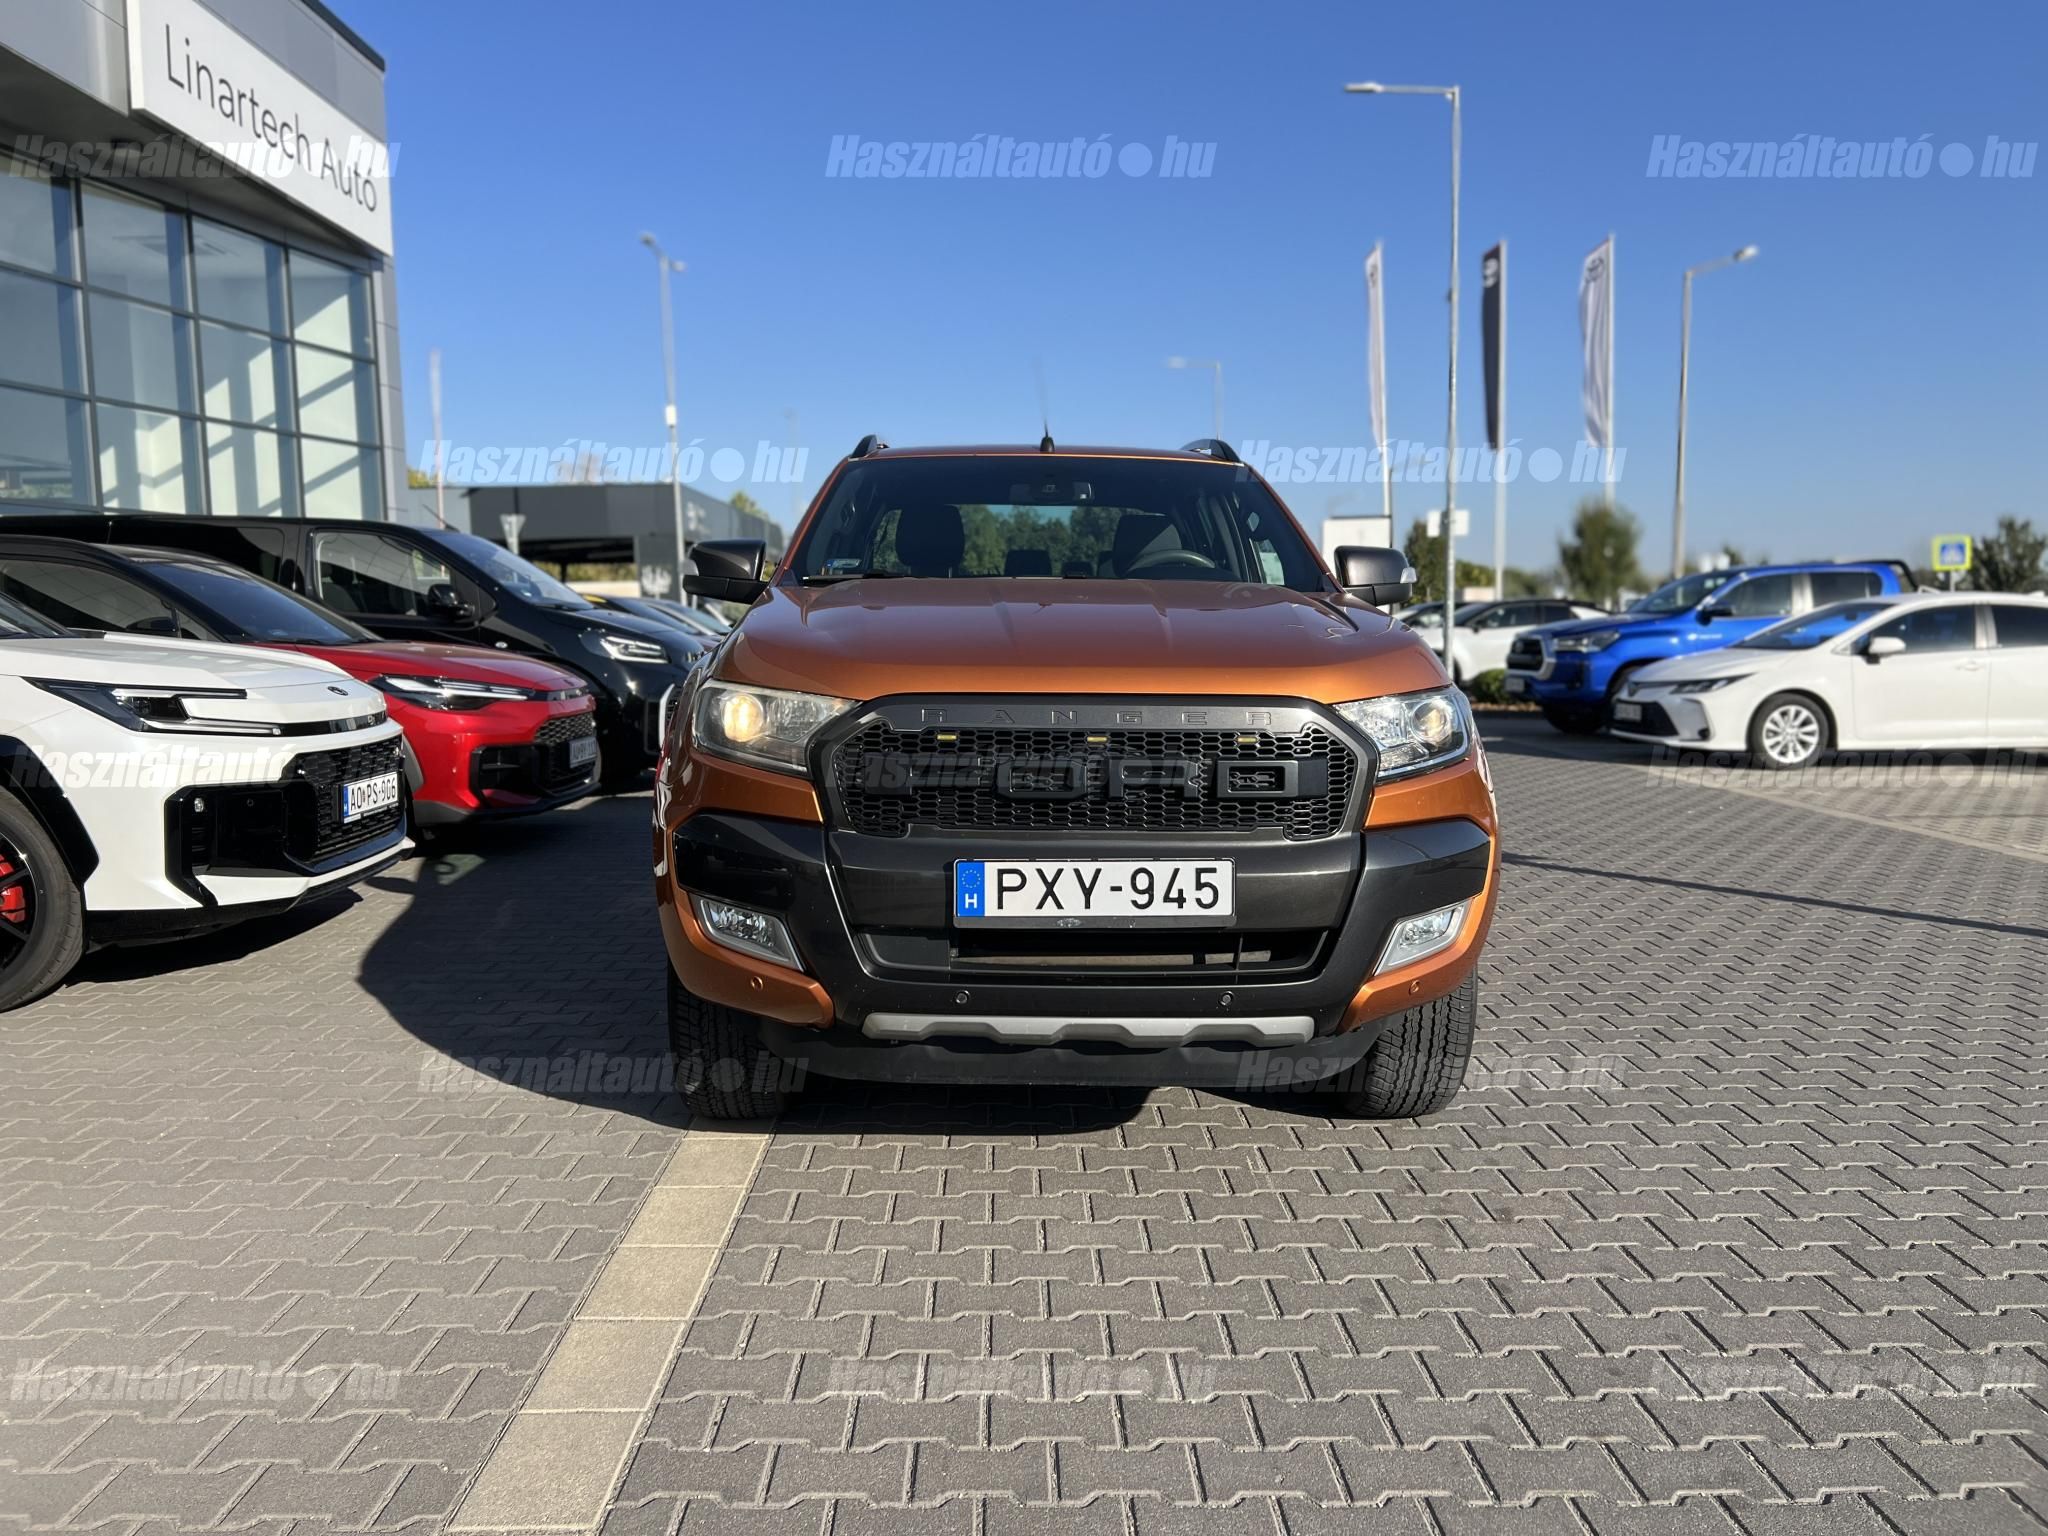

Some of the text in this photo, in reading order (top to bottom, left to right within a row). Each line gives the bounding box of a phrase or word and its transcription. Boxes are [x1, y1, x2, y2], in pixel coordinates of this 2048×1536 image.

[165, 23, 378, 212] Linartech Autó
[920, 707, 1273, 726] RANGER
[864, 753, 1328, 798] FORD
[965, 893, 977, 909] H
[996, 867, 1219, 910] PXY-945
